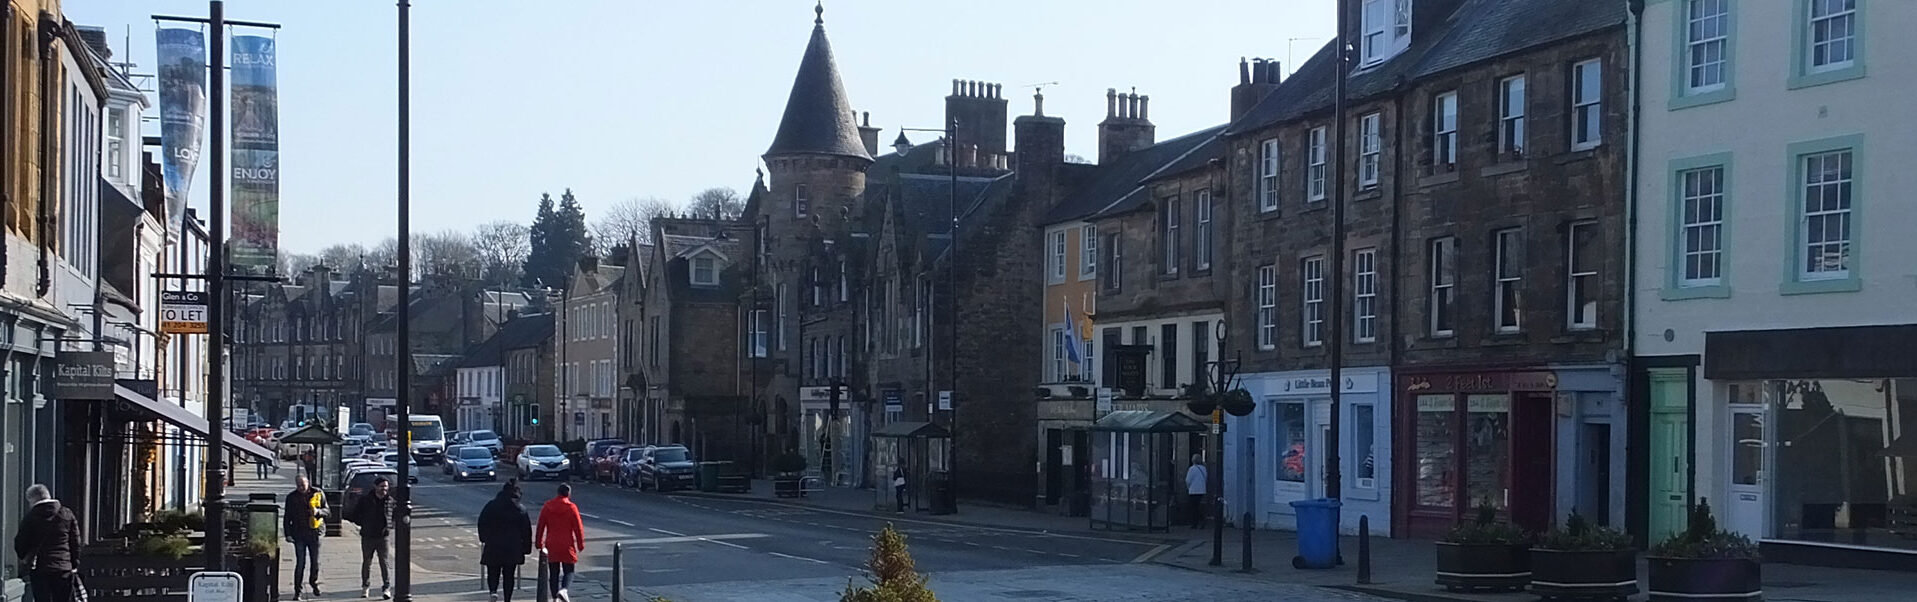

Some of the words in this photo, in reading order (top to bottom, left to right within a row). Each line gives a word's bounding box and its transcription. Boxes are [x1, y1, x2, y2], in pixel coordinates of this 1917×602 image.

[233, 52, 274, 66] RELAX
[233, 167, 277, 180] ENJOY
[162, 292, 180, 300] Glen
[187, 293, 199, 301] Co
[181, 310, 203, 321] LET
[58, 363, 91, 380] Kapital
[92, 364, 112, 377] Kilts
